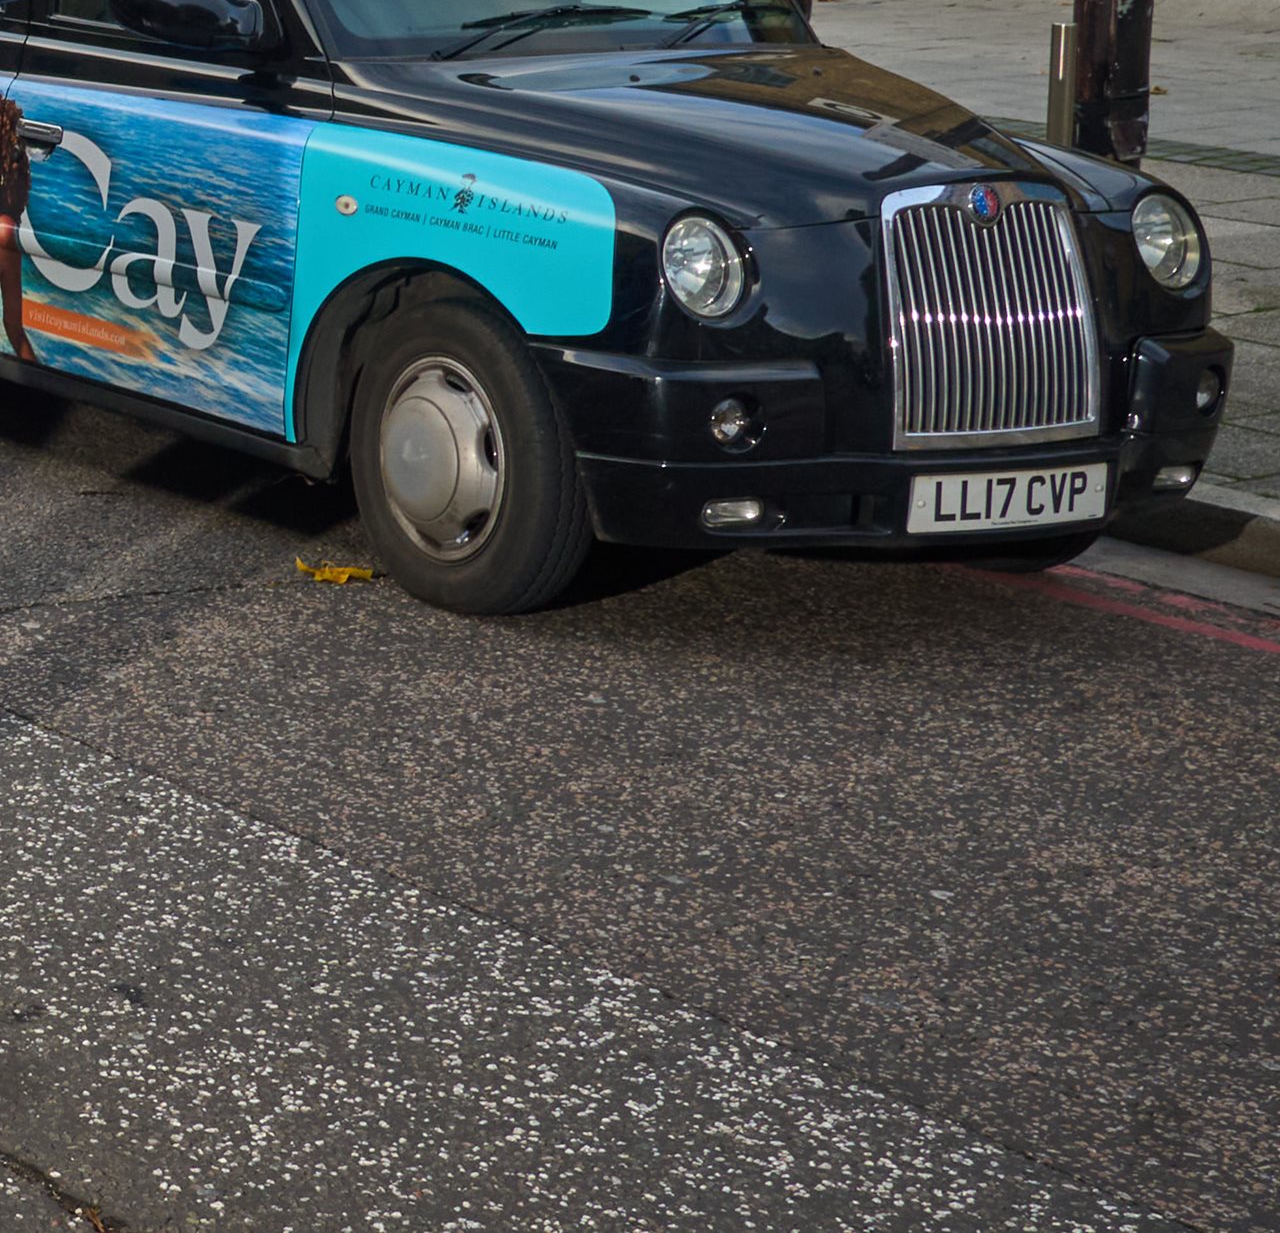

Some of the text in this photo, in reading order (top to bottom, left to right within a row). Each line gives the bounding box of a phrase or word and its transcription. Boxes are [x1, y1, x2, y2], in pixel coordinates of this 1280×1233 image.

[370, 174, 569, 225] CAYMAN ISLANDS
[365, 204, 558, 250] GRAND CAYMAN CAYMAN BRAC LITTLE CAYMAN
[28, 308, 126, 346] visitcaymanislands.com
[934, 471, 1088, 522] LL17 CVP
